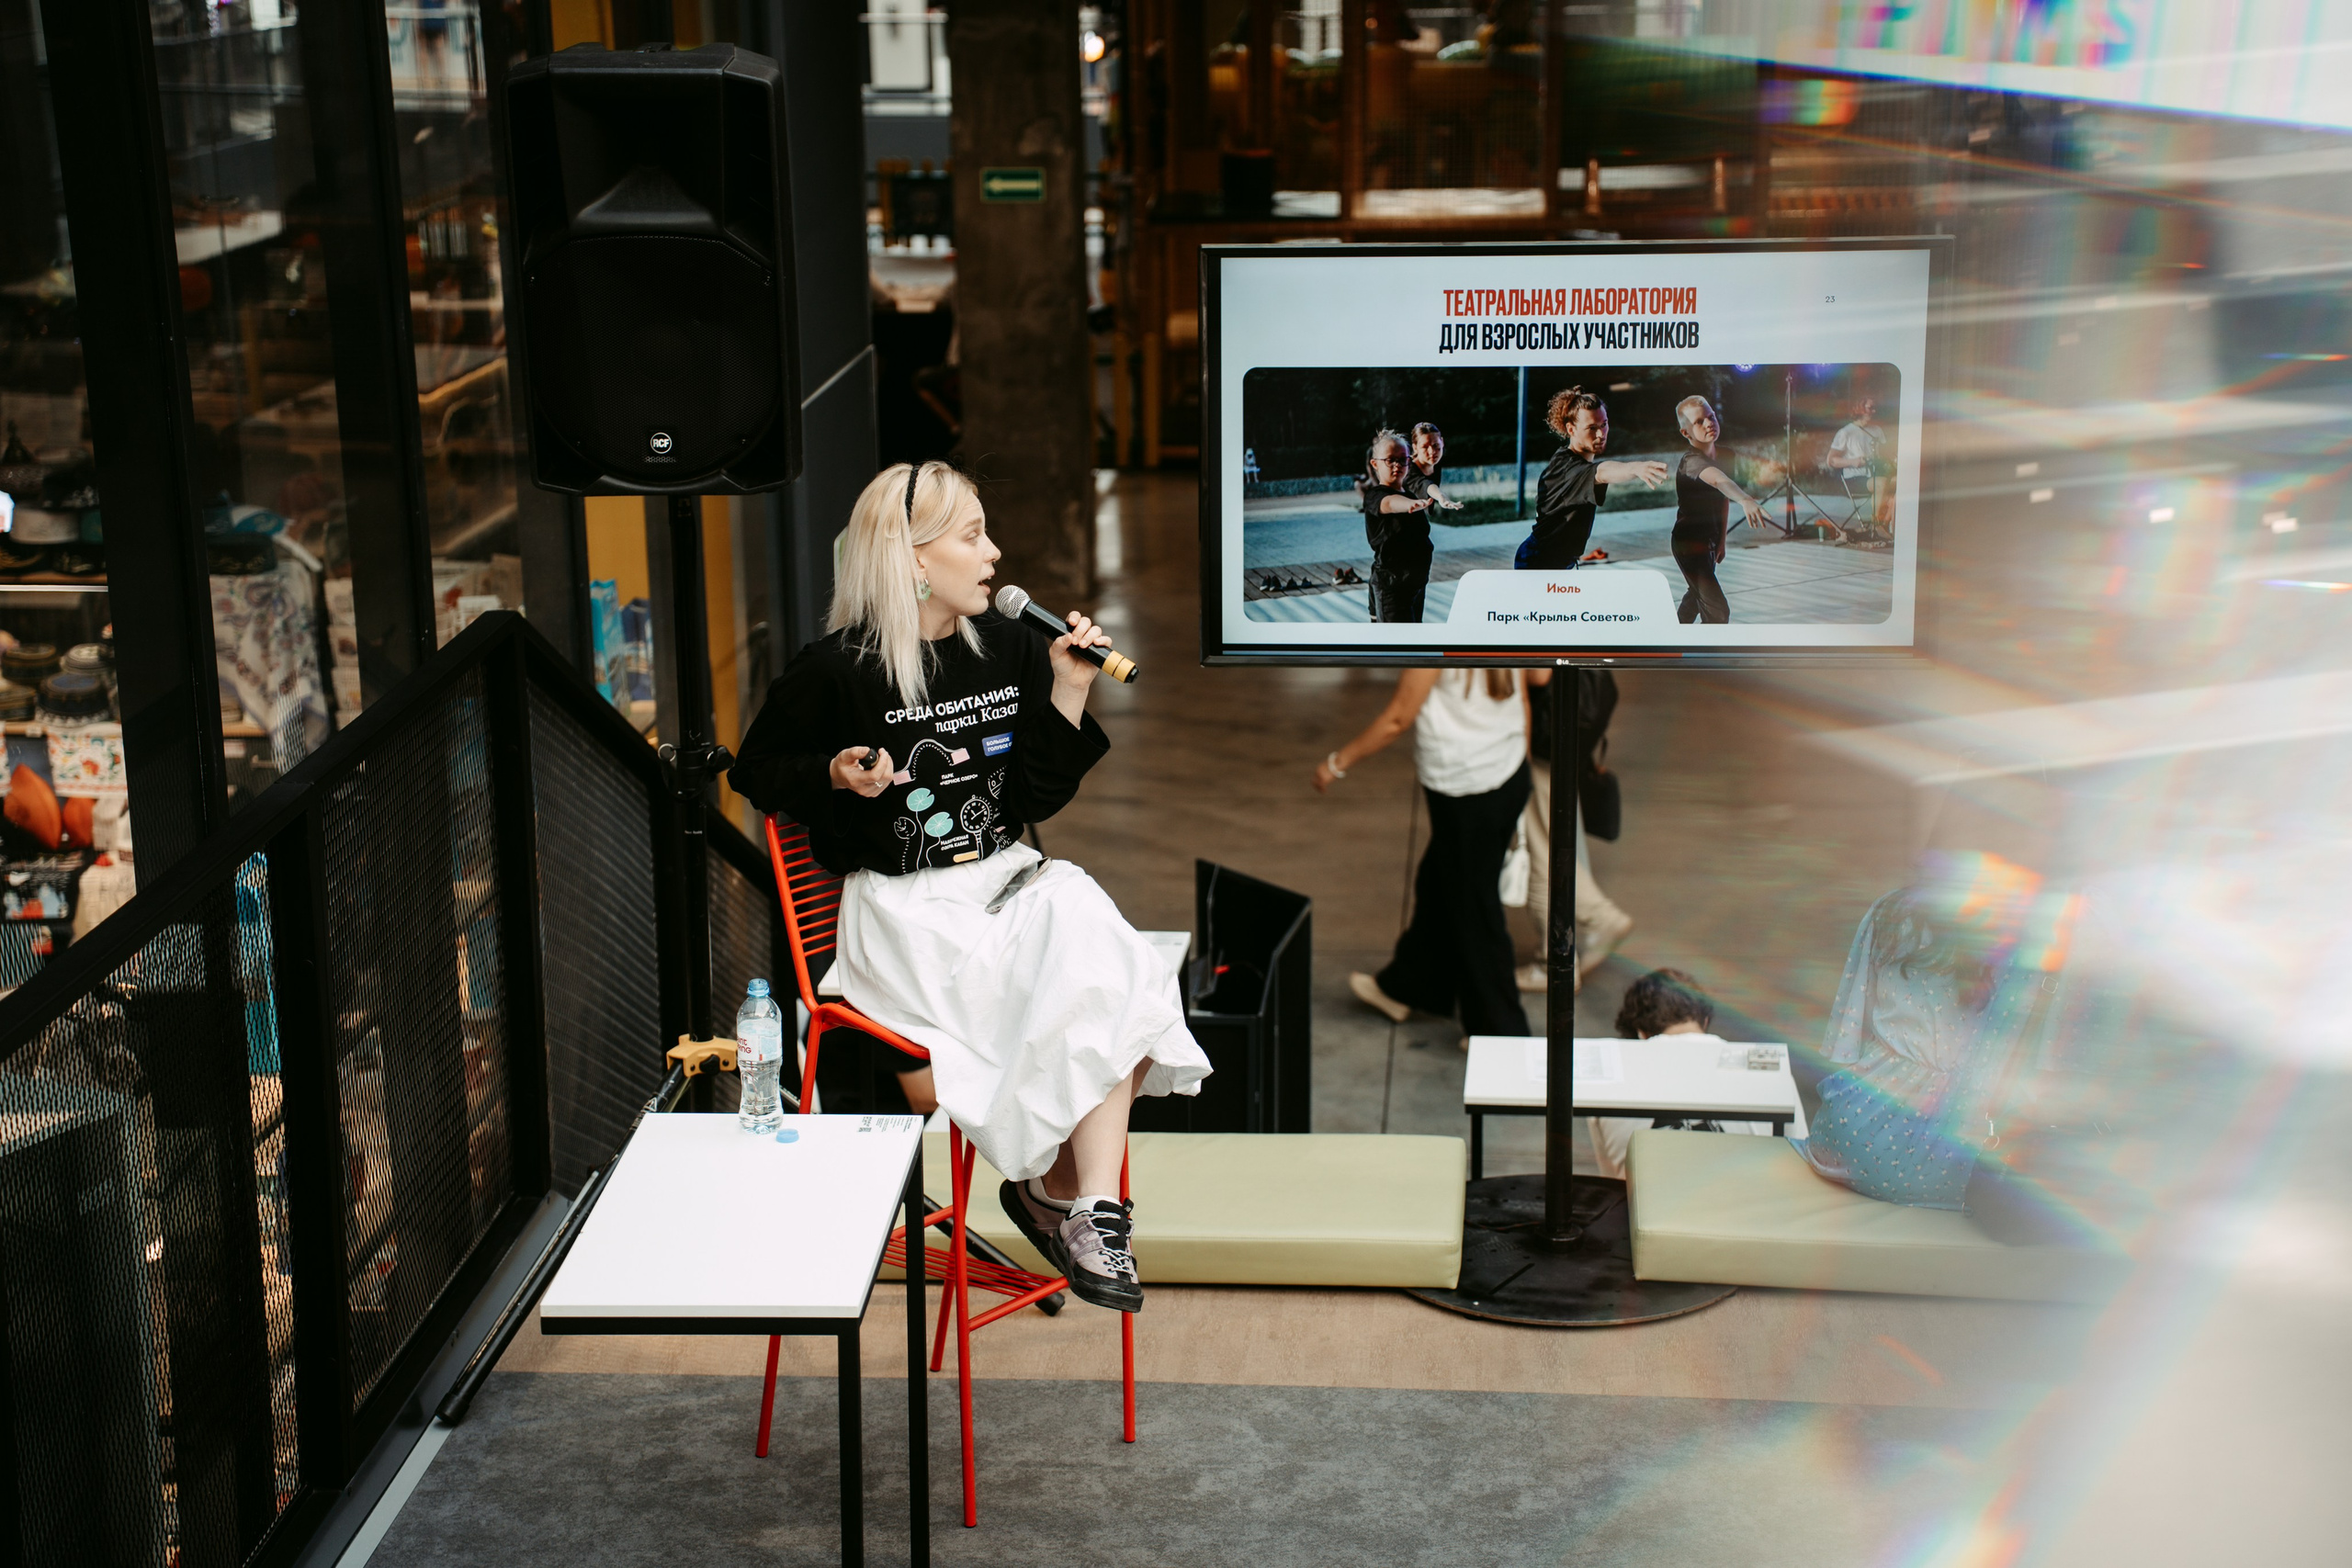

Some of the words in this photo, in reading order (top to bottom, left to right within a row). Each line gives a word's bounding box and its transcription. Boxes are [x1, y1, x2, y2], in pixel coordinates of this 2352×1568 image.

[1442, 288, 1566, 317] ТЕАТРАЛЬНАЯ
[1569, 287, 1697, 315] ЛАБОРАТОРИЯ
[1825, 295, 1836, 303] 23
[1439, 323, 1478, 354] ДЛЯ
[1481, 322, 1580, 350] ВЗРОСЛЫХ
[1584, 321, 1700, 349] УЧАСТНИКОВ
[652, 438, 670, 448] RCF
[1546, 582, 1581, 593] Июль
[1487, 611, 1520, 625] Парк
[1523, 611, 1577, 625] «Крылья
[1580, 611, 1640, 623] Советов»
[885, 705, 934, 725] СРЕДА
[934, 685, 1020, 716] ОБИТАНИЯ:
[934, 714, 978, 734] парки
